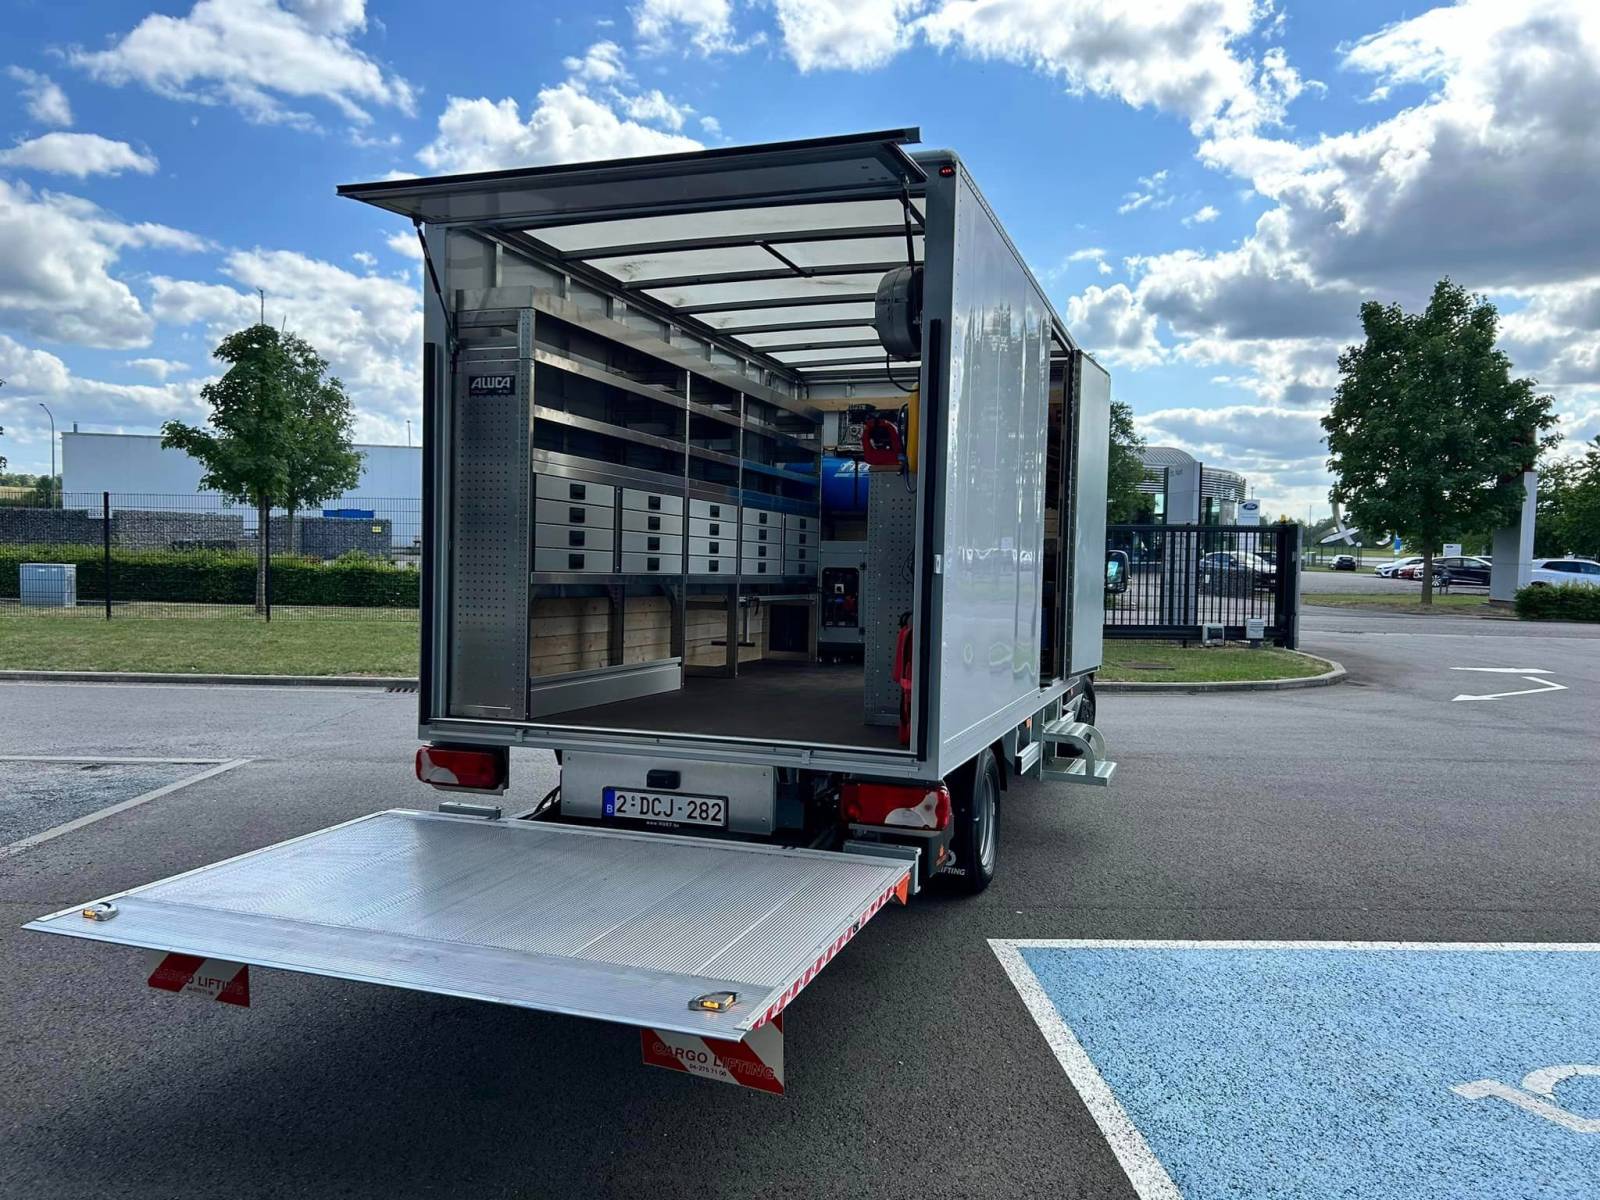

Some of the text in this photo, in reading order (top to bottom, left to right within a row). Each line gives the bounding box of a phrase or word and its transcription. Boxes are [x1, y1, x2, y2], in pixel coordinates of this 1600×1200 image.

[471, 376, 511, 389] ALUCA
[606, 804, 613, 814] B
[652, 1041, 775, 1080] CARGO LIFTING
